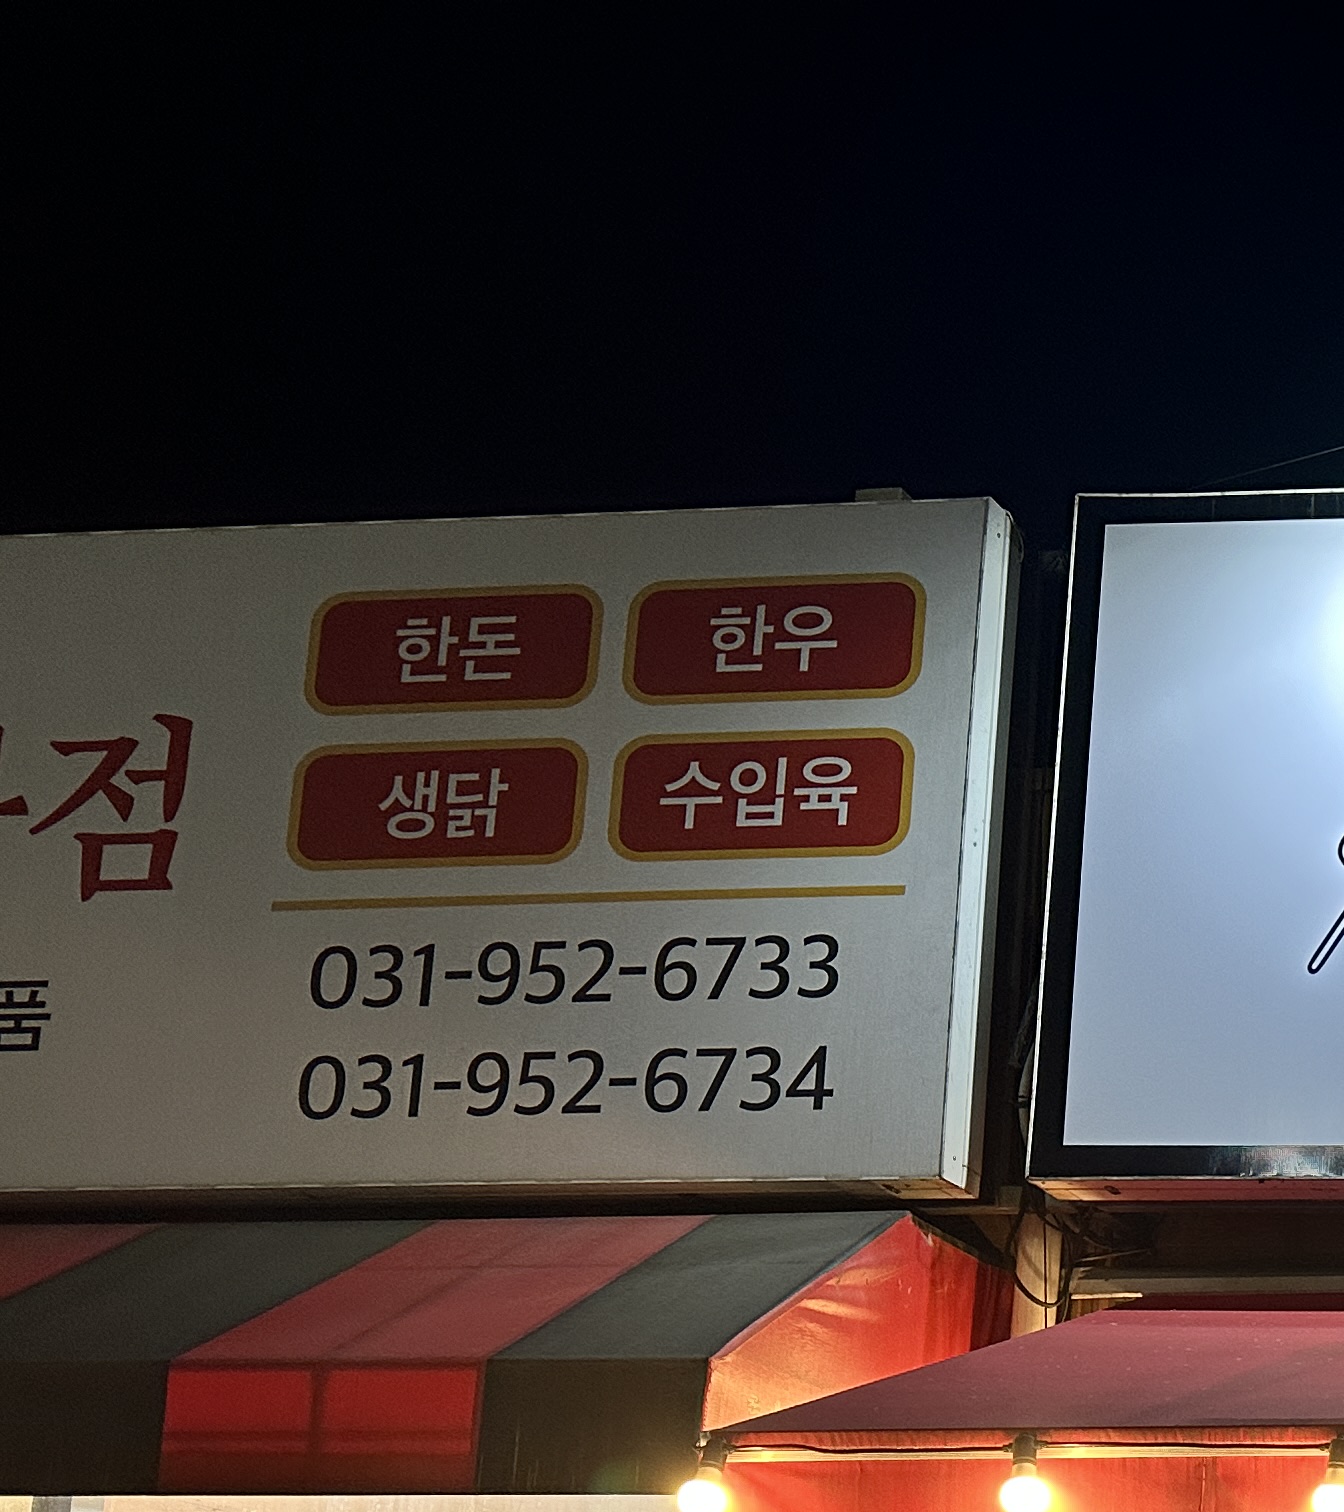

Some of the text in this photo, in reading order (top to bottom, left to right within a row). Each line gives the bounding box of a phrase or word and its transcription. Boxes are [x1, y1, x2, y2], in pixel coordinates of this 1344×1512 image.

[395, 614, 523, 683] 한돈
[710, 603, 838, 673] 한우
[0, 714, 195, 902] 점
[377, 768, 509, 841] 생닭
[659, 757, 859, 828] 수입육
[308, 934, 840, 1010] 031-952-6733
[298, 1045, 834, 1120] 031-952-6734
